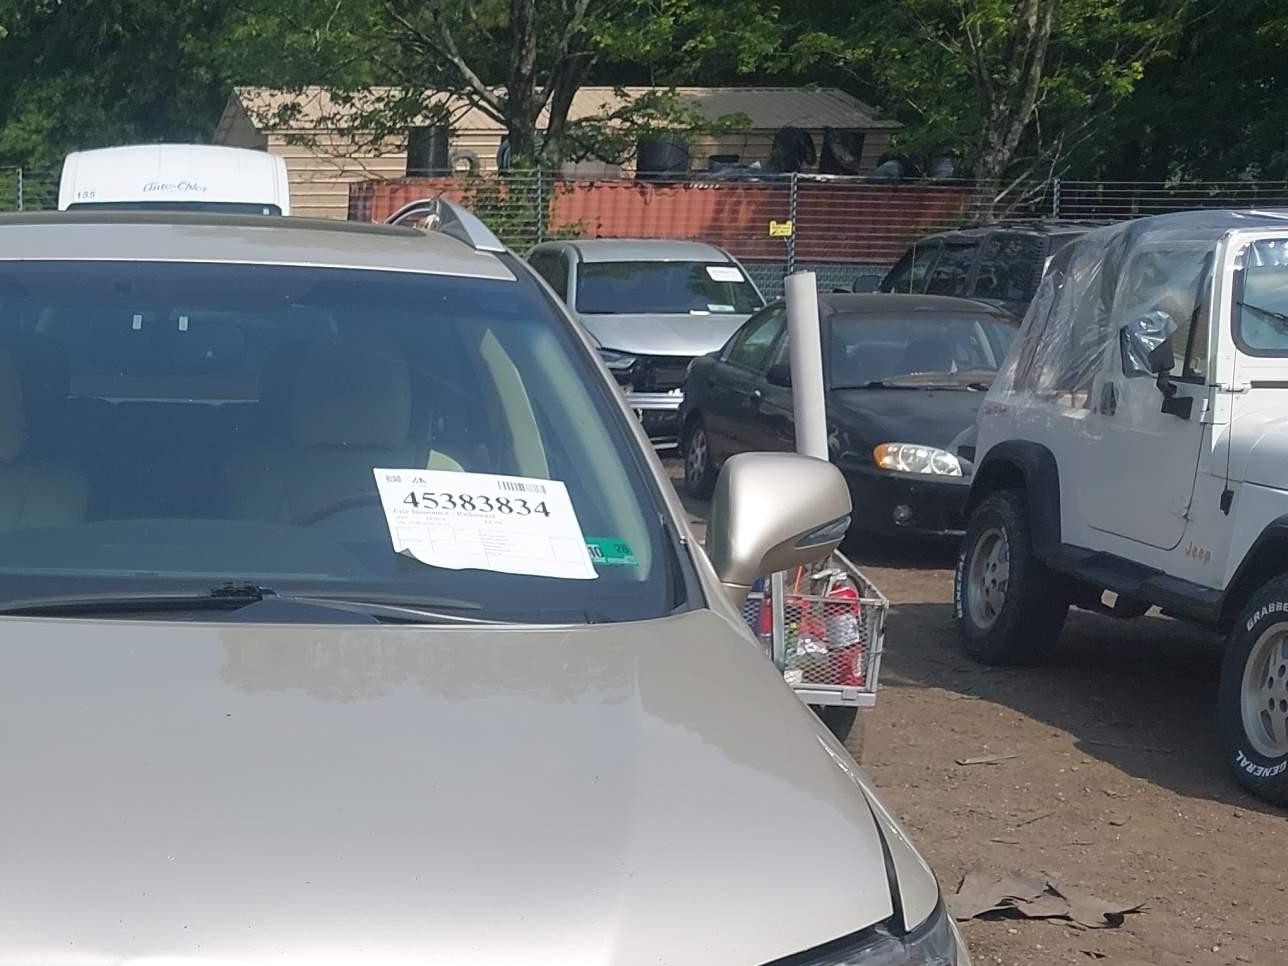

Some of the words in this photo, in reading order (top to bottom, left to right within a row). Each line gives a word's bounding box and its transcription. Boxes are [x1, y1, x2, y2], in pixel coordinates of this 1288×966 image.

[403, 492, 550, 517] 45383834
[1185, 541, 1211, 565] Jeep
[1236, 749, 1288, 777] GENERAL
